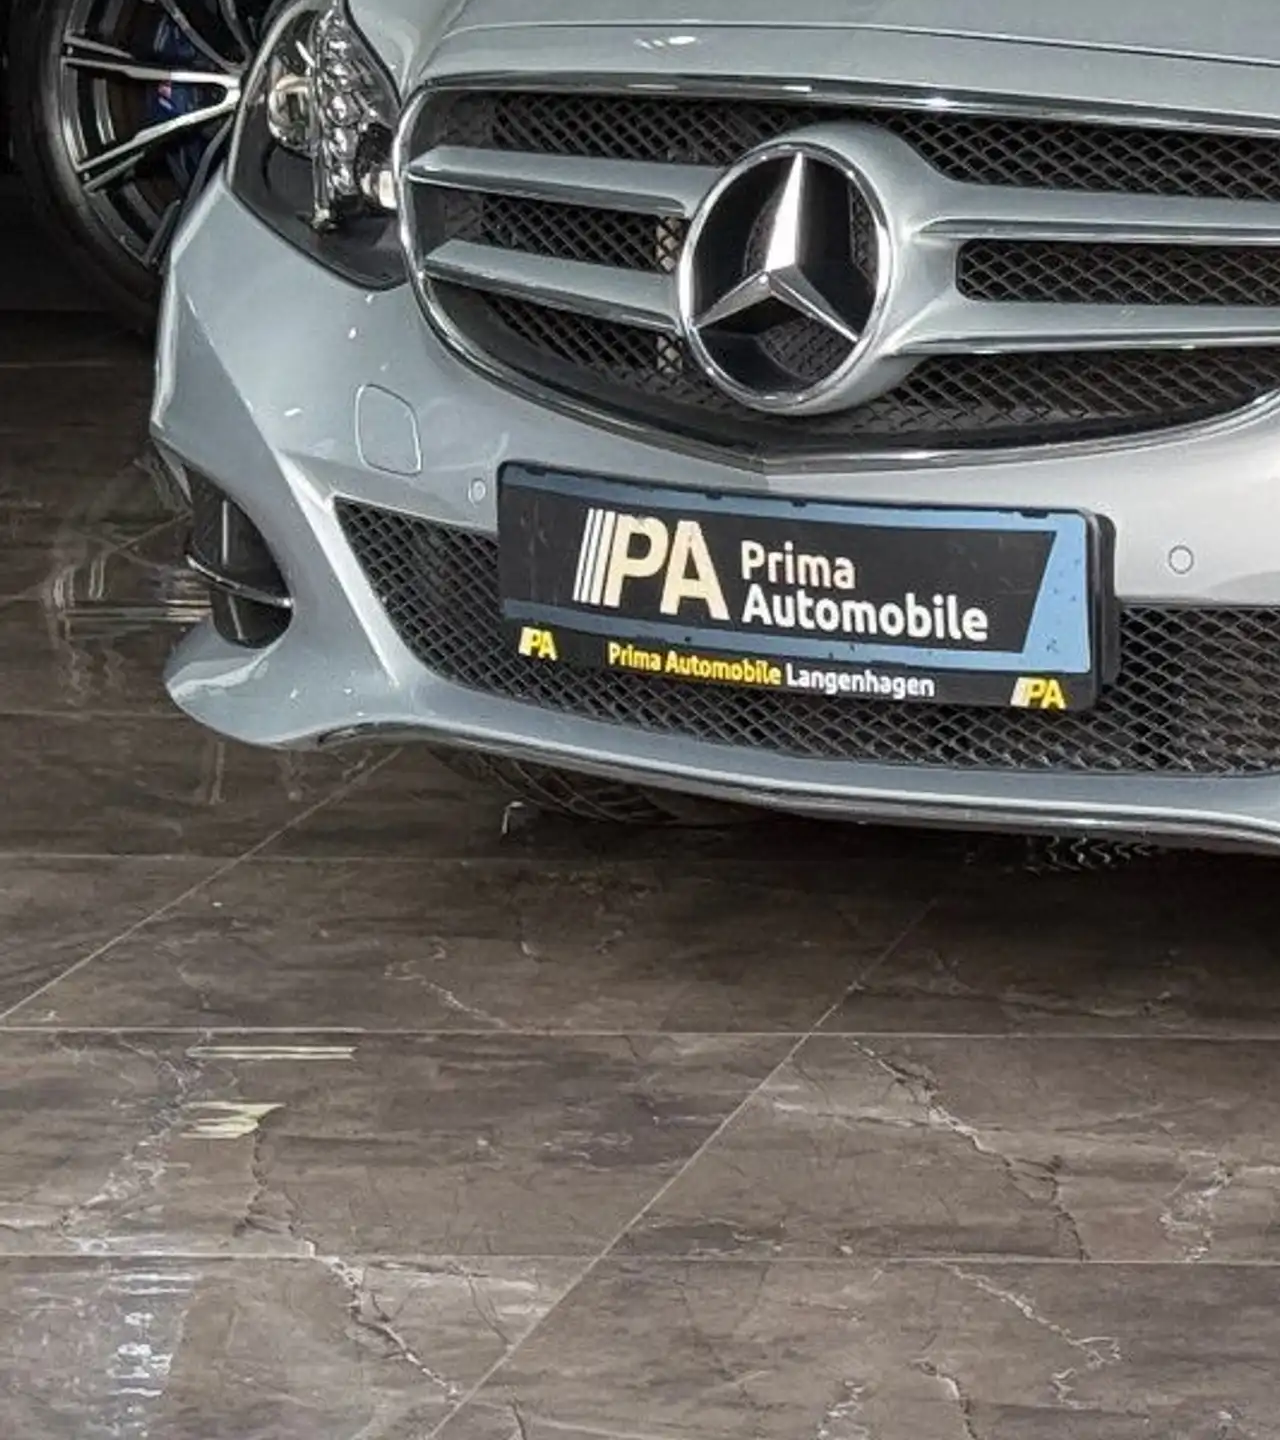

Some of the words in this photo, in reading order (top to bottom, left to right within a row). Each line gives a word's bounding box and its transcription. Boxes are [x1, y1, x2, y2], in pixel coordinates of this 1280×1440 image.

[604, 514, 731, 621] PA
[740, 540, 856, 590] Prima
[742, 583, 989, 642] Automobile
[608, 642, 662, 672] Prima
[664, 649, 782, 686] Automobile
[785, 662, 935, 700] Langenhagen
